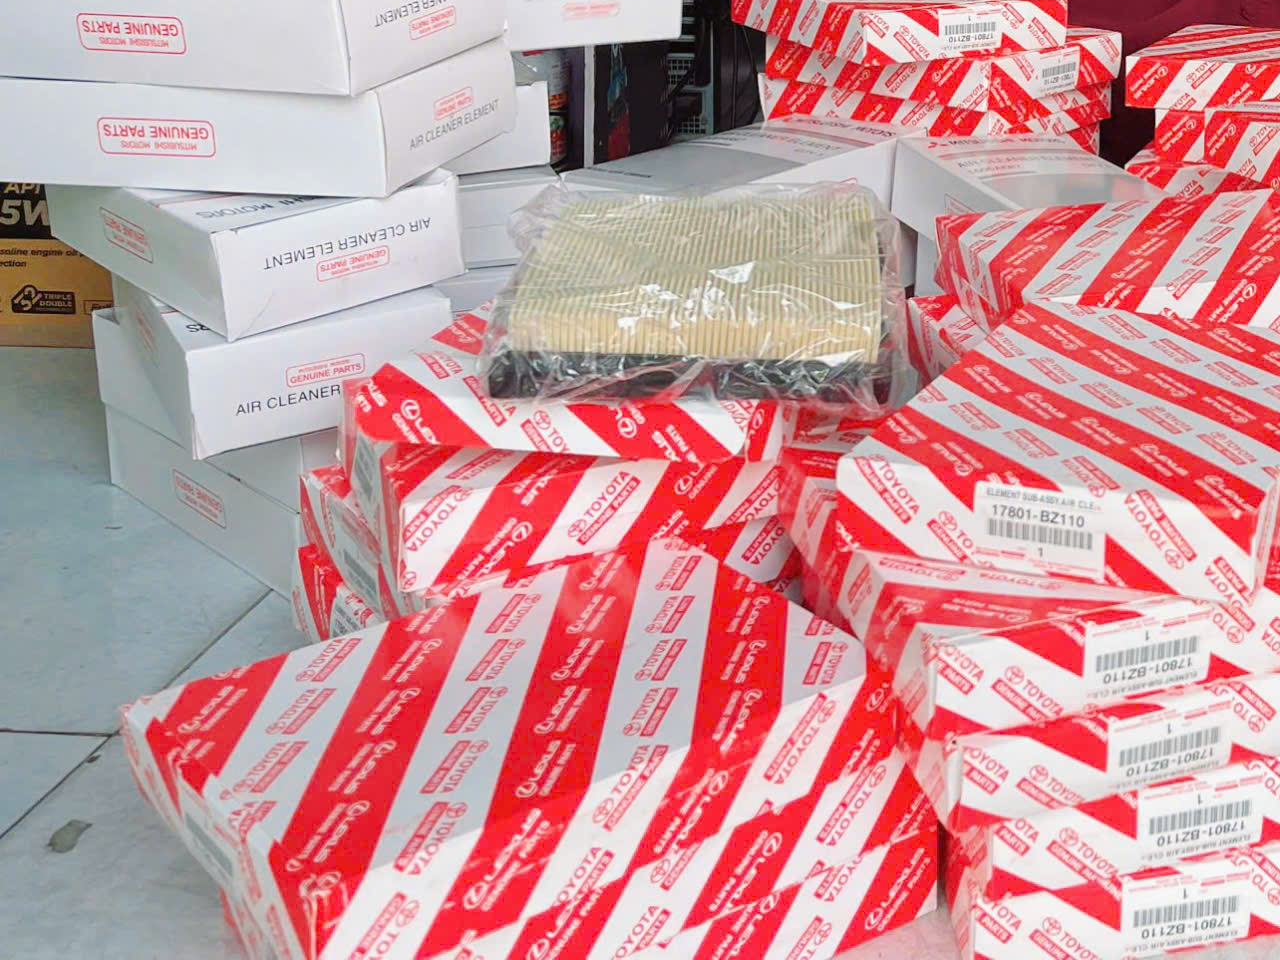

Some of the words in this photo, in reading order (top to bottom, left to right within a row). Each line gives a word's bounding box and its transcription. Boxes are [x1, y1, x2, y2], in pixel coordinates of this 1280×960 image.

[82, 19, 124, 35] PARTS
[126, 21, 179, 37] GENUINE
[103, 122, 145, 138] PARTS
[150, 124, 209, 140] GENUINE
[408, 135, 427, 151] AIR
[426, 116, 464, 144] CLEANER
[462, 98, 499, 126] ELEMENT
[339, 224, 406, 249] CLEANER
[409, 216, 431, 232] AIR
[264, 243, 334, 271] ELEMENT
[289, 370, 331, 385] GENUINE
[332, 362, 362, 377] PARTS
[236, 400, 262, 416] AIR
[267, 385, 341, 409] CLEANER
[584, 470, 631, 518] TOYOTA
[878, 461, 919, 515] TOYOTA
[405, 501, 458, 553] TOYOTA
[992, 503, 1085, 528] 17801-BZ110
[1123, 492, 1169, 551] TOYOTA
[1103, 657, 1193, 685] 17801-BZ110
[1125, 747, 1215, 778] 17801-BZ110
[1156, 818, 1246, 846] 17801-BZ110
[1141, 915, 1233, 939] 17801-BZ110
